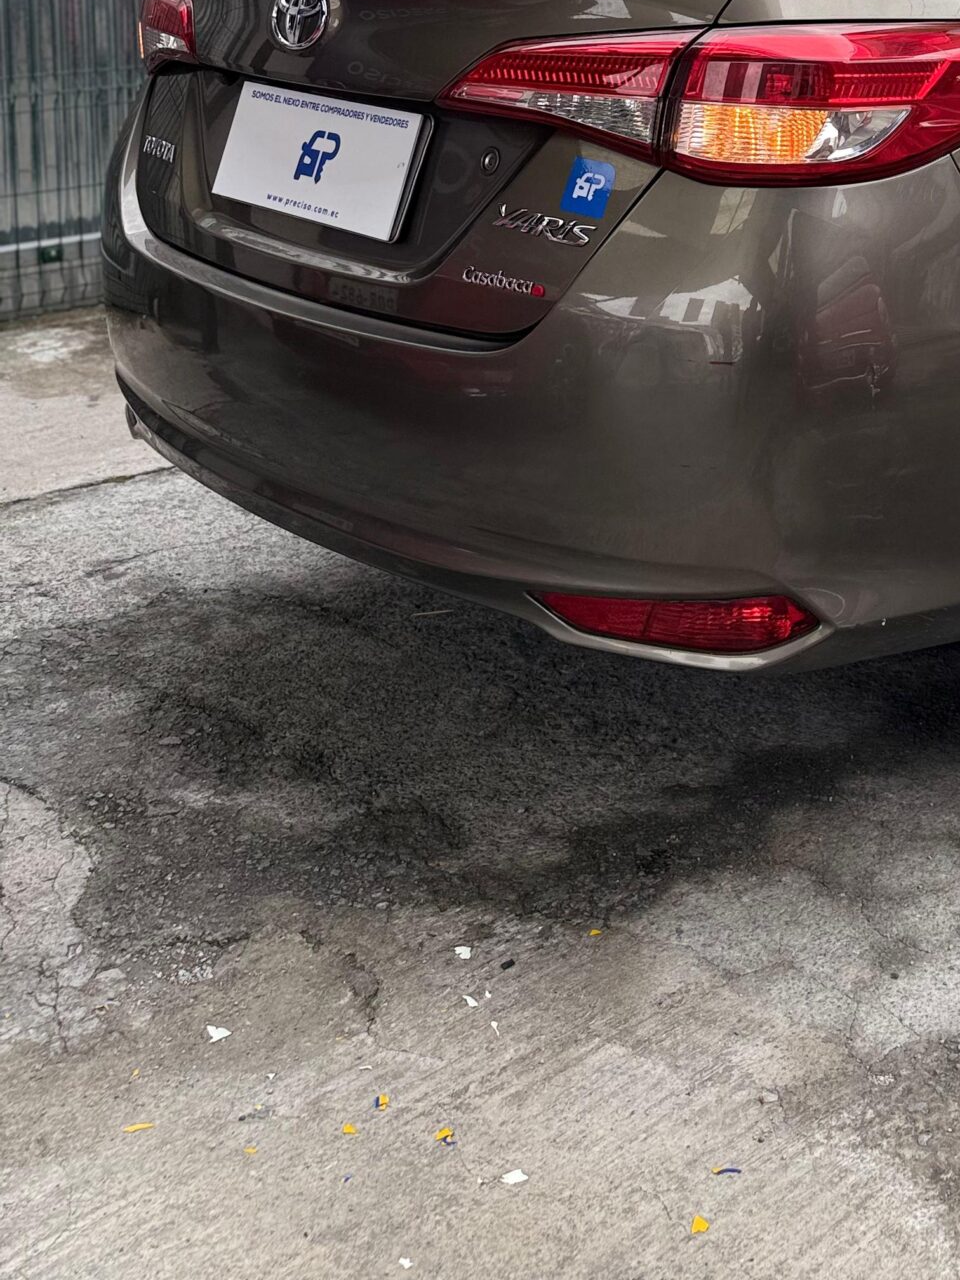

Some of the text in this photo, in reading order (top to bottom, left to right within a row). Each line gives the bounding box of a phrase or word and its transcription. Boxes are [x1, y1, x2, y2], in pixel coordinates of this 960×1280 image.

[251, 89, 410, 129] SOMOS EL NEXO ENTRE COMPRADORES Y VENDEDORES
[143, 134, 176, 164] TOYOTA
[266, 192, 339, 219] www.preciso.com.ec
[462, 265, 533, 296] Casabaca
